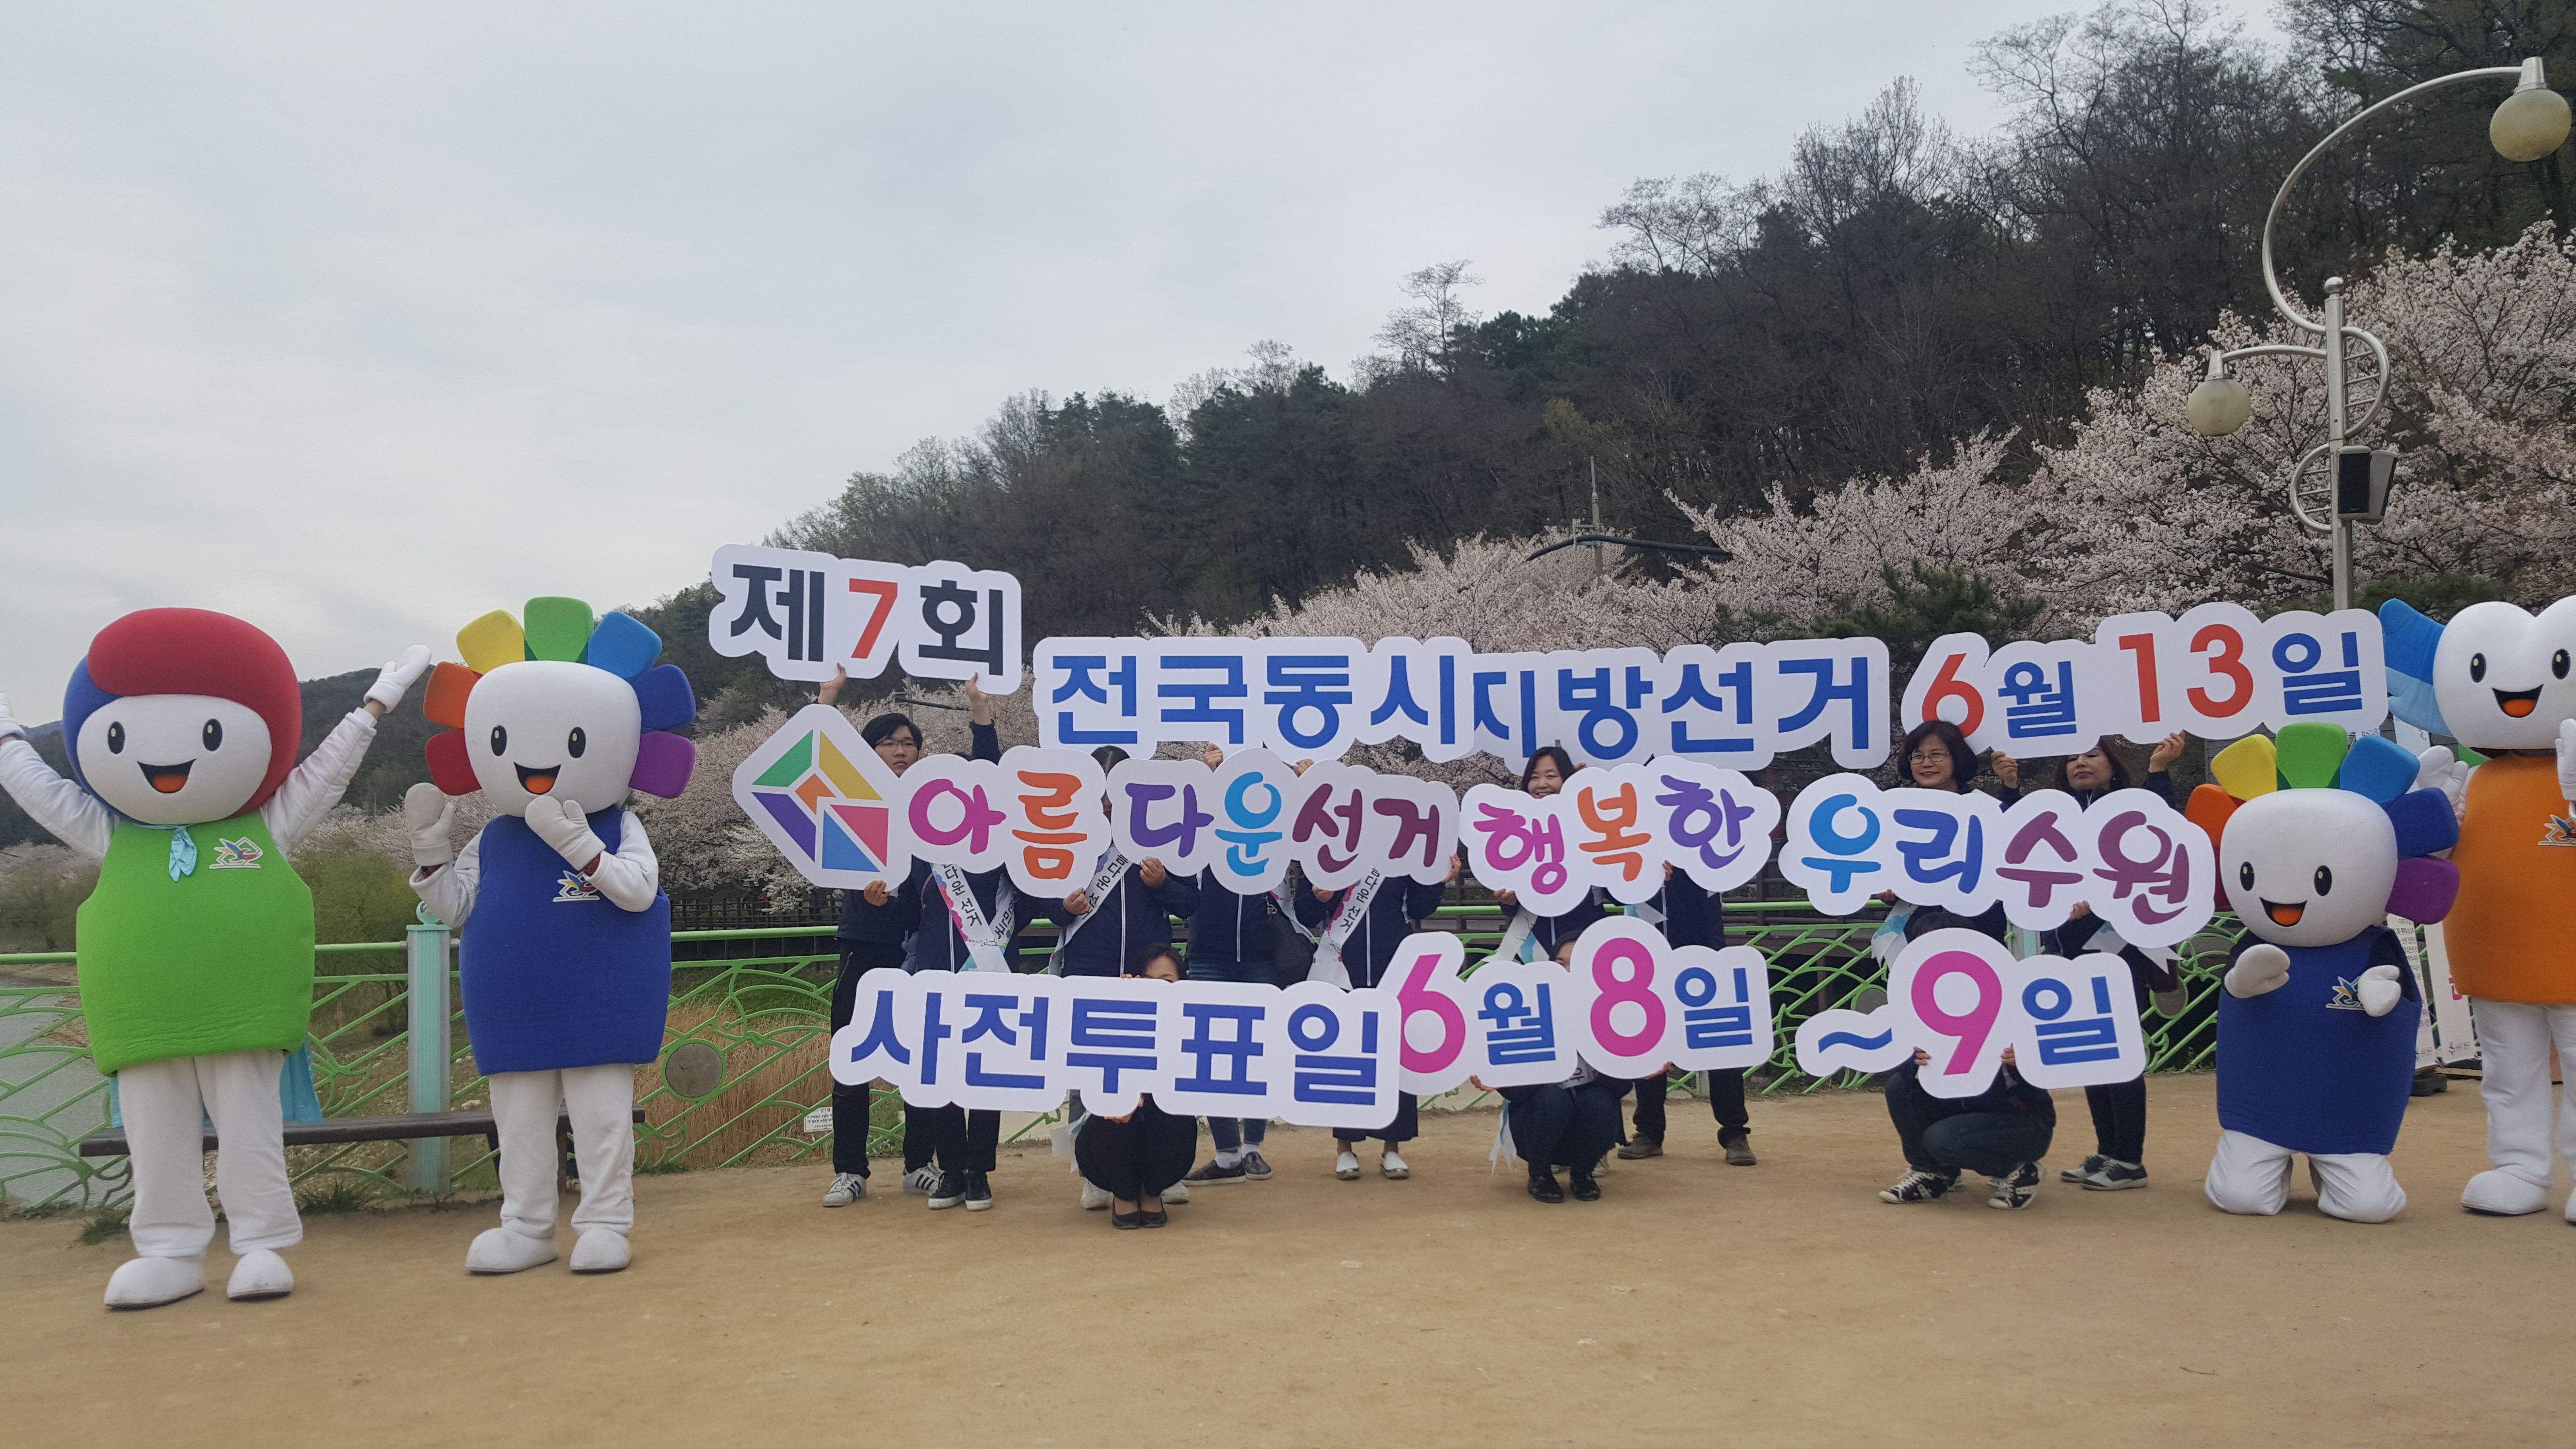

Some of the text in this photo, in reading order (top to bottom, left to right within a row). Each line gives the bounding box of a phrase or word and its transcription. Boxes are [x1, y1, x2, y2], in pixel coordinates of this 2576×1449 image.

[730, 564, 1003, 676] 제7회
[1473, 775, 1755, 895] 행복한
[961, 897, 982, 927] 선거
[1340, 906, 1361, 933] 선거
[851, 990, 1378, 1106] 사전투표일
